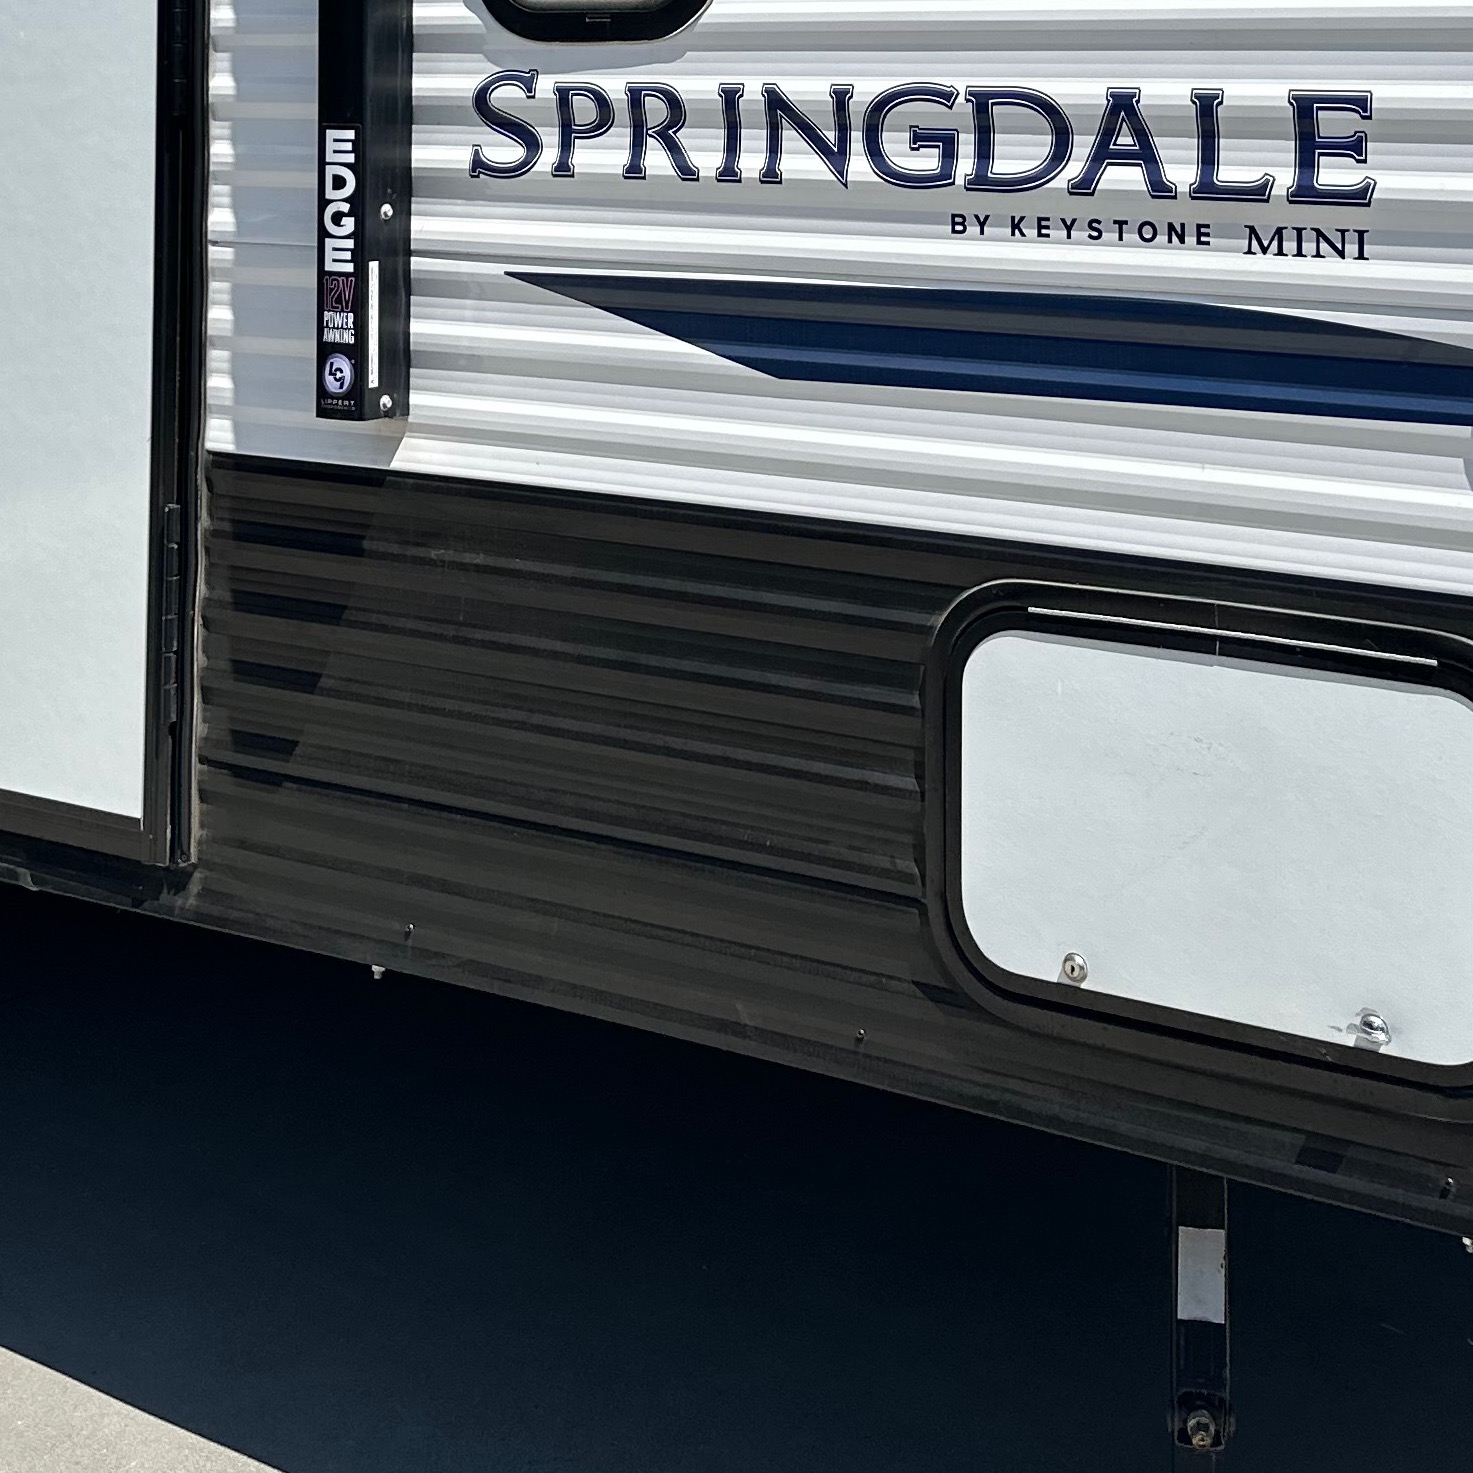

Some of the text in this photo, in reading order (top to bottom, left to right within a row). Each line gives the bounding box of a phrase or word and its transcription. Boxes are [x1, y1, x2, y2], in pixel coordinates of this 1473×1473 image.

[468, 68, 1377, 207] SPRINGDALE
[323, 129, 356, 273] EDGE
[950, 213, 1370, 261] BY KEYSTONE MINI
[323, 276, 356, 312] 12V
[322, 327, 356, 344] AWNING
[323, 311, 355, 329] POWER
